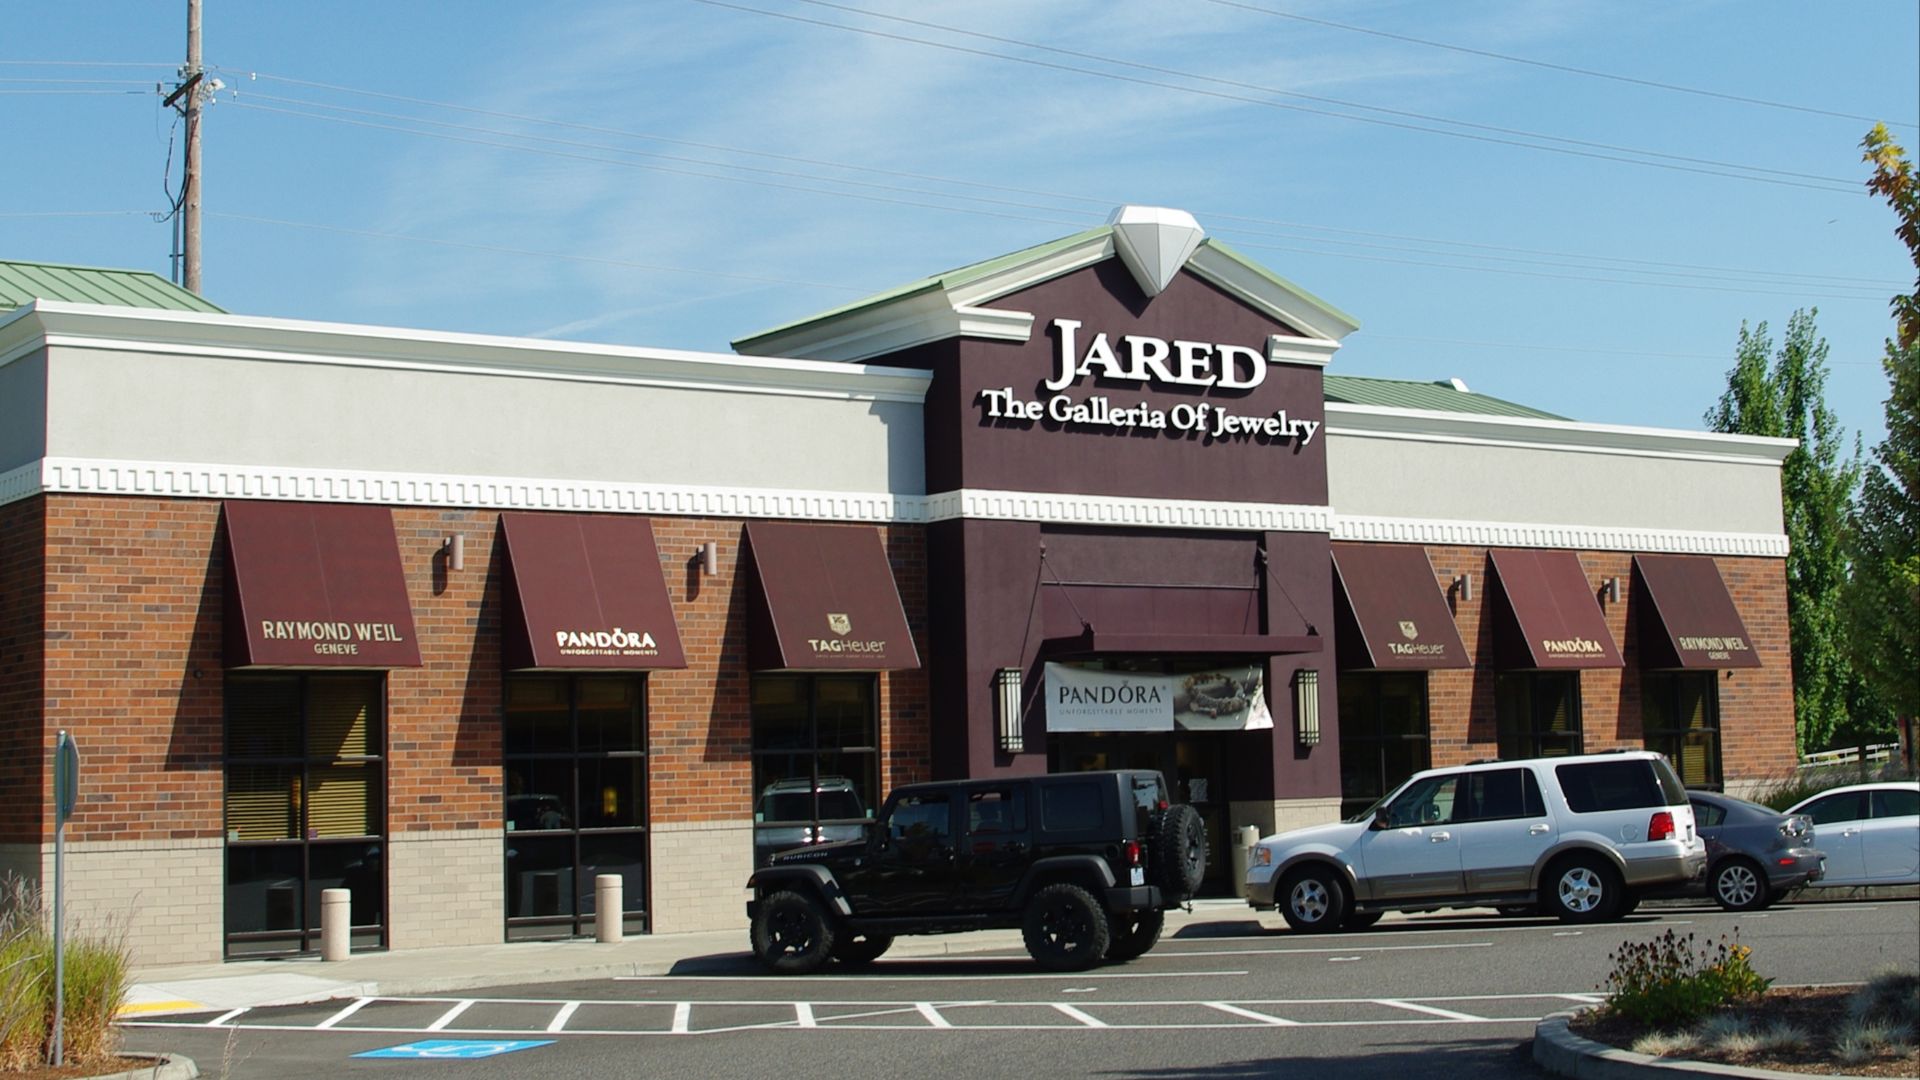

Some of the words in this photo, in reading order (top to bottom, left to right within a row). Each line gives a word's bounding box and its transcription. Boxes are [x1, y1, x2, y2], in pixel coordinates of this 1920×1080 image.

[1045, 318, 1267, 391] JARED
[982, 387, 1043, 420] The
[1049, 395, 1166, 429] Galleria
[1171, 403, 1209, 431] Of
[1212, 407, 1320, 445] Jewelry
[262, 620, 351, 641] RAYMOND
[354, 623, 403, 642] WEIL
[314, 643, 359, 655] GENEVE
[560, 648, 621, 656] UNFORGETTABLE
[1679, 637, 1724, 651] RAYMOND
[1722, 637, 1749, 650] WEIL
